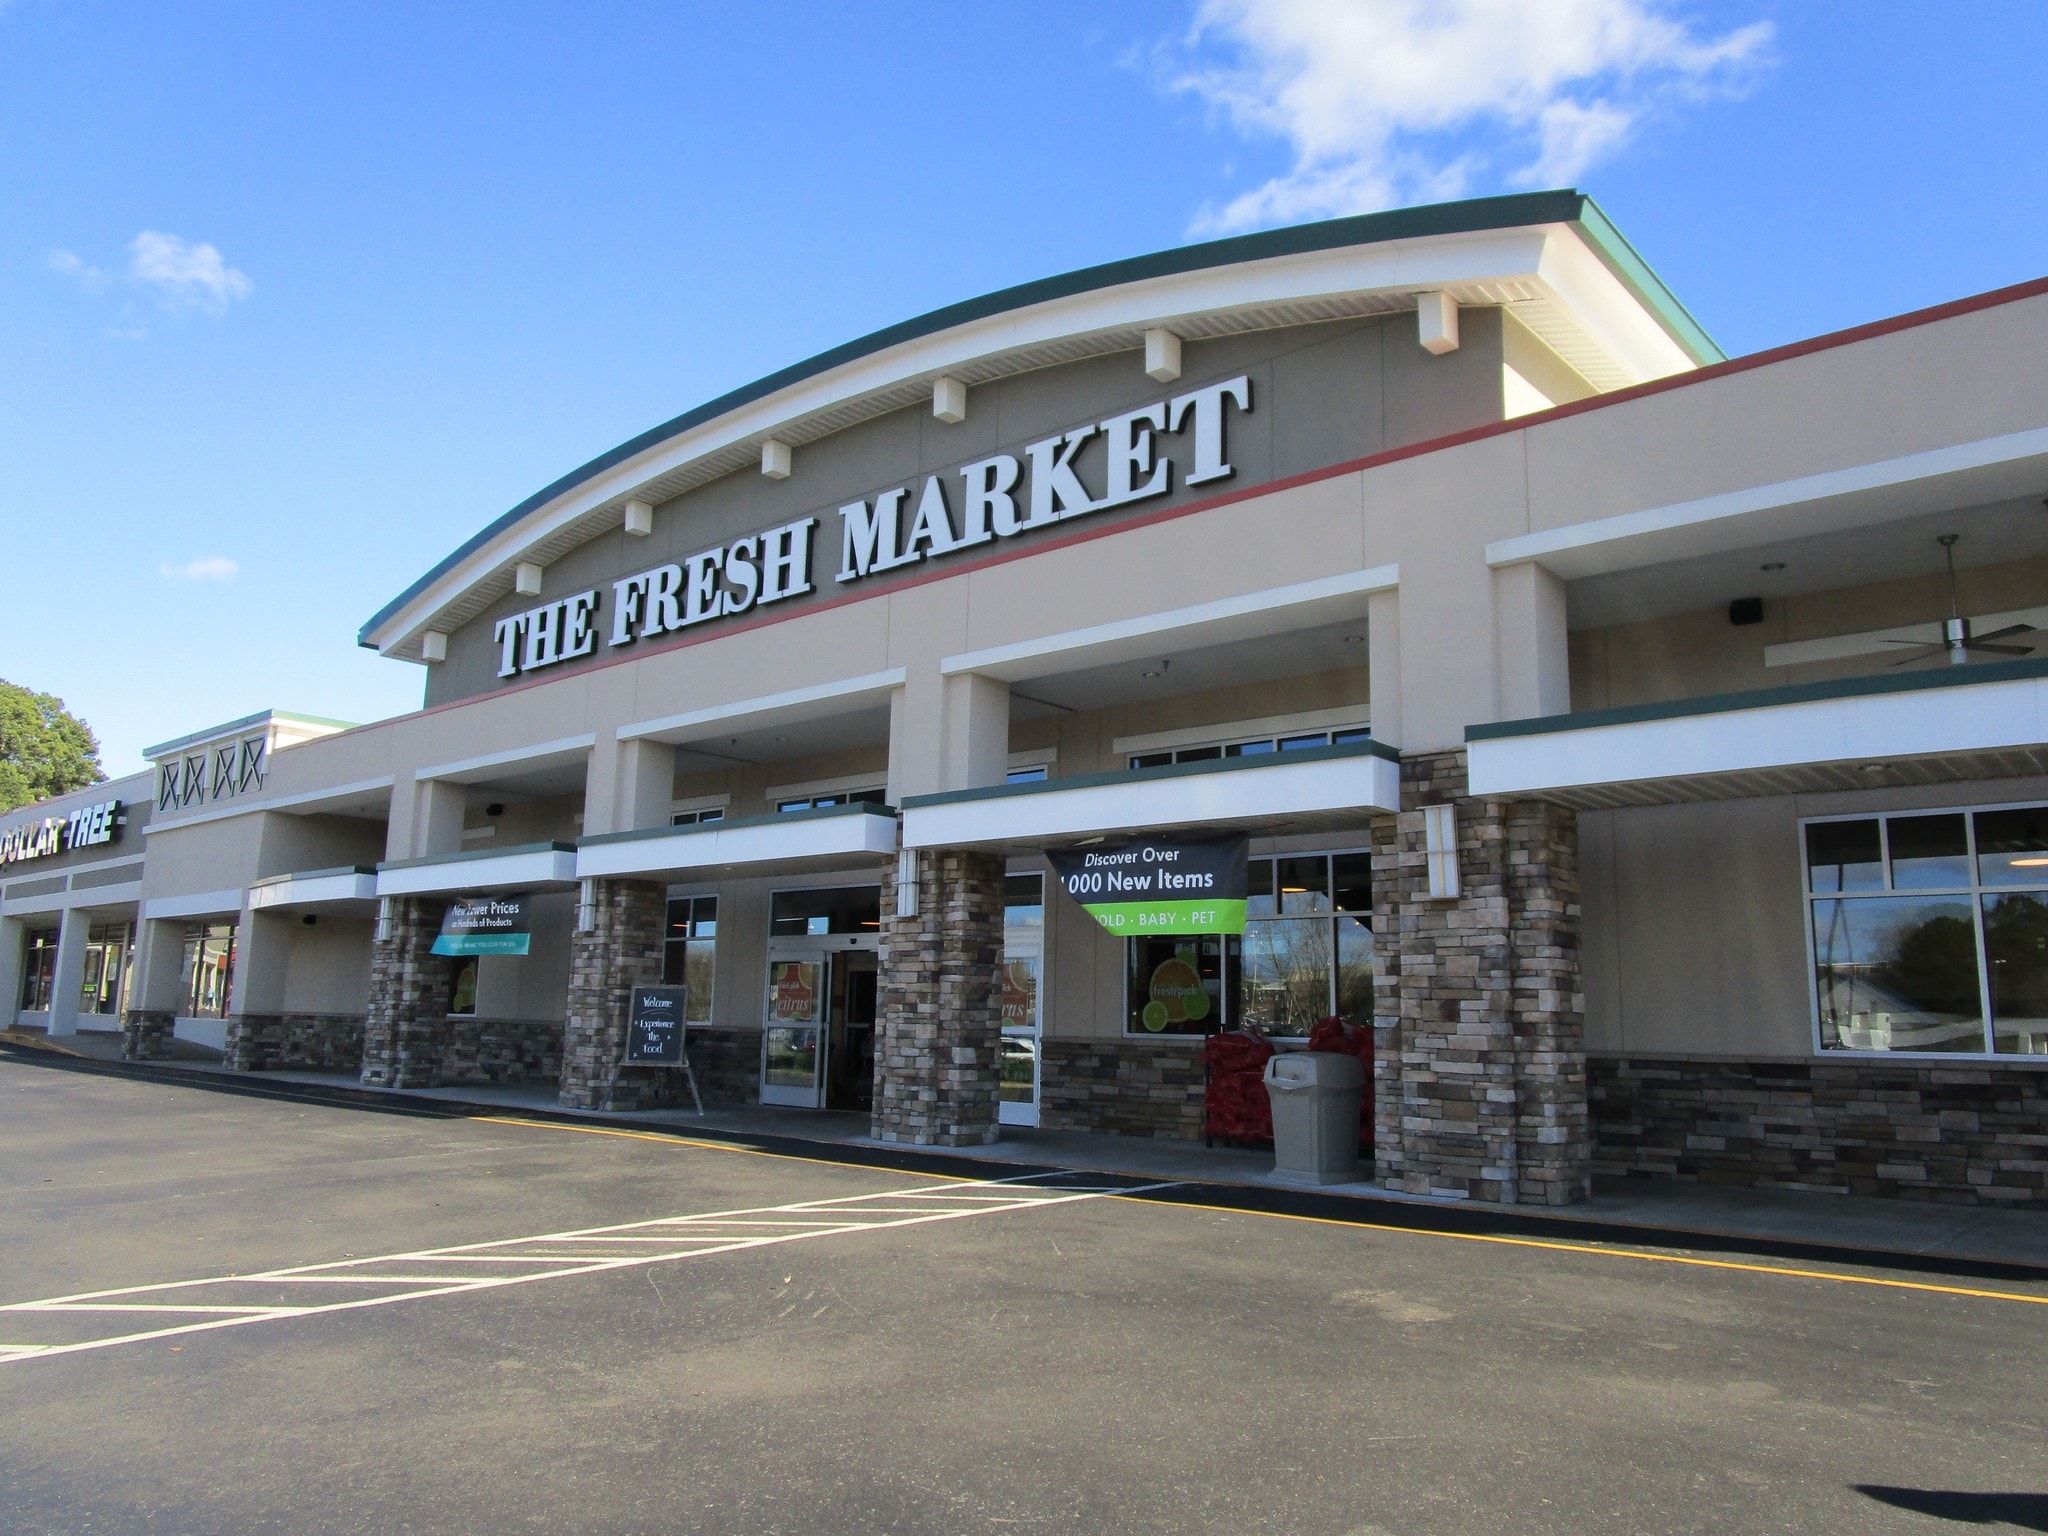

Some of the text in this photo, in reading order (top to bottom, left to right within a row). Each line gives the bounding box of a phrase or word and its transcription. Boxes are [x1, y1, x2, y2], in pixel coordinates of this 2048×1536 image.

[494, 375, 1254, 679] THE FRESH MARKET
[67, 800, 119, 849] TREE
[1084, 847, 1180, 867] Discover Over
[1060, 869, 1213, 894] 000 New Items
[451, 901, 519, 916] New Lower Prices
[479, 917, 486, 927] of
[486, 917, 512, 927] Products
[1139, 912, 1176, 926] BABY
[1191, 911, 1216, 924] PET
[643, 995, 673, 1008] Welcome
[777, 996, 809, 1011] citrus
[640, 1018, 675, 1031] Experience
